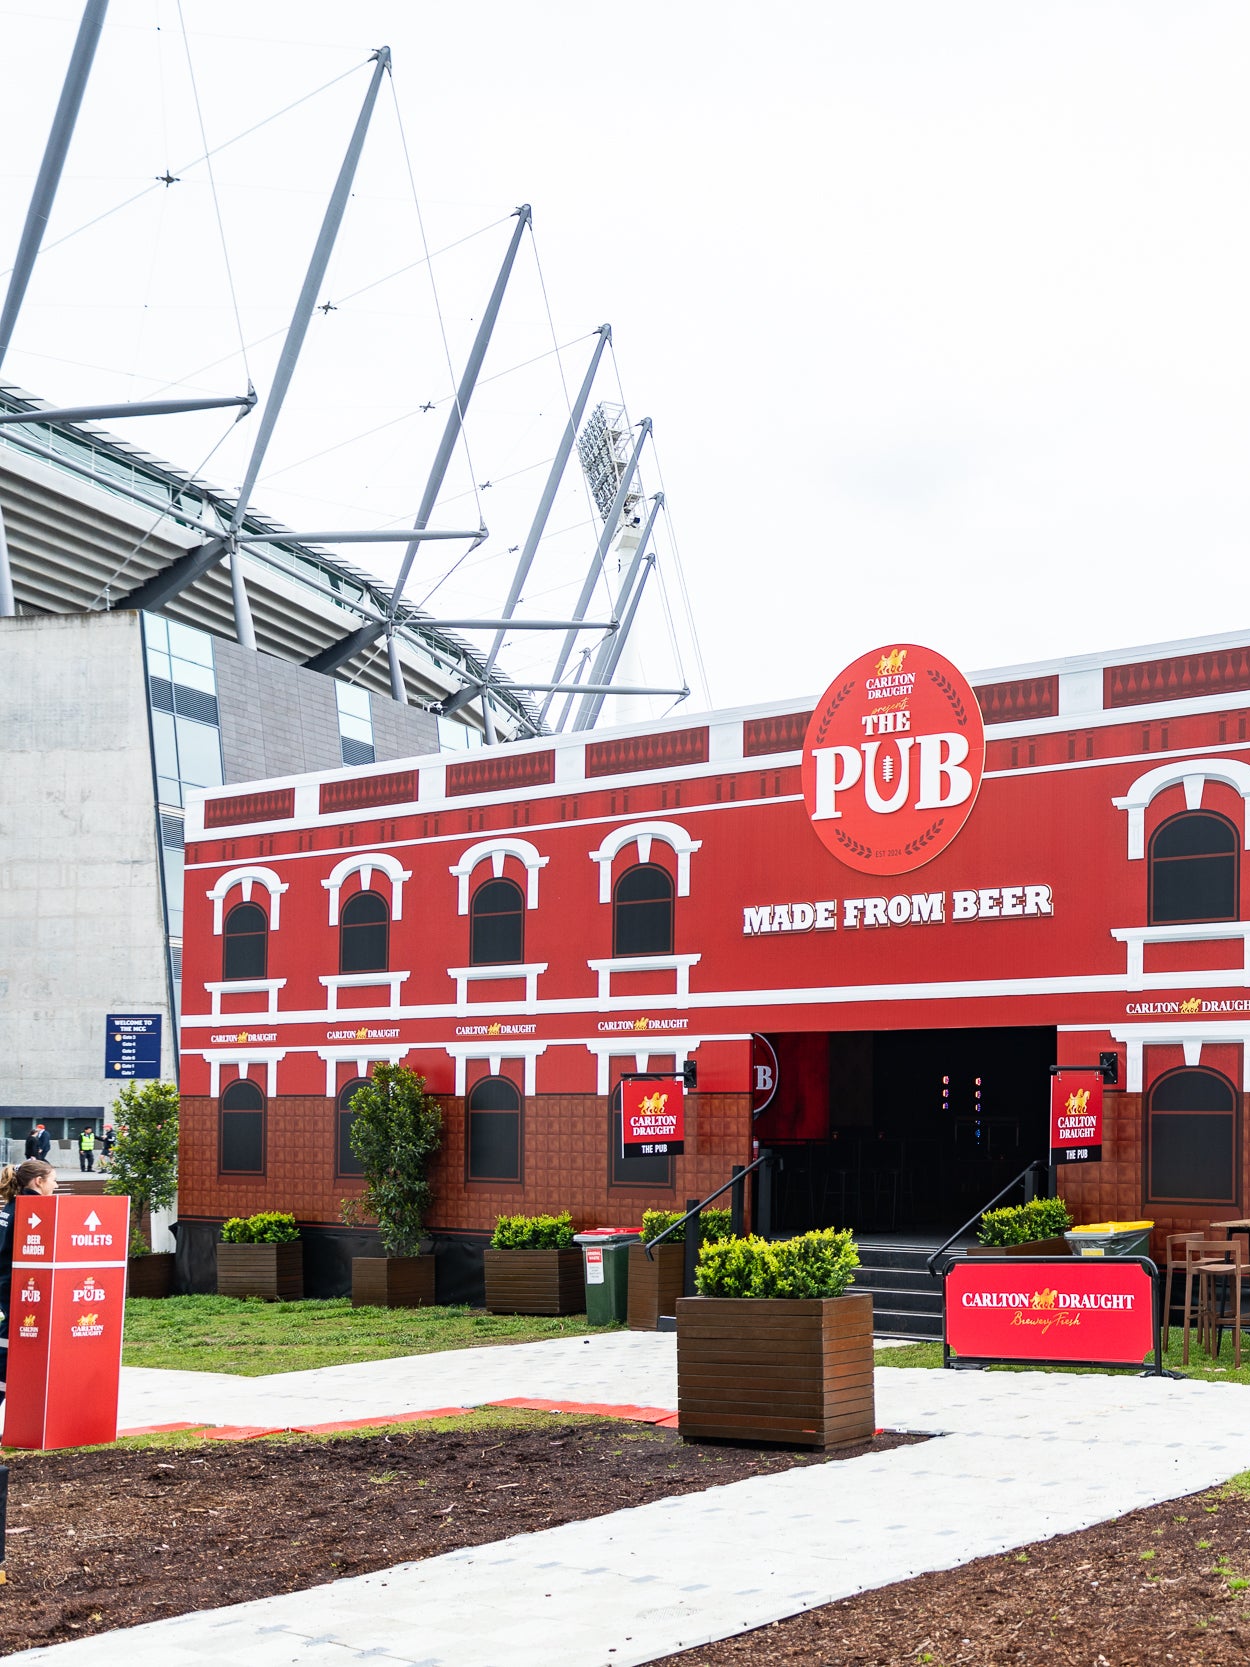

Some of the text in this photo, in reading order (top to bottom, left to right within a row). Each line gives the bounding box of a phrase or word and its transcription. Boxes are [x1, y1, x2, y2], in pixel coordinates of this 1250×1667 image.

[865, 672, 916, 690] CARLTON
[867, 684, 914, 700] DRAUGHT
[861, 710, 911, 736] THE
[811, 732, 973, 821] PUB
[743, 883, 1054, 936] MADE FROM BEER
[1126, 1000, 1180, 1015] CARLTON
[455, 1023, 537, 1035] CARLTON DRAUGHT
[598, 1018, 689, 1031] CARLTON DRAUGHT
[211, 1032, 278, 1043] CARLTON DRAUGHT
[327, 1028, 400, 1039] CARLTON DRAUGHT
[630, 1115, 677, 1127] CARLTON
[1057, 1116, 1097, 1128] CARLTON
[633, 1126, 676, 1136] DRAUGHT
[1059, 1128, 1095, 1139] DRAUGHT
[641, 1144, 668, 1154] THE PUB
[1066, 1149, 1088, 1160] THE PUB
[27, 1234, 41, 1245] BEER
[71, 1234, 113, 1247] TOILETS
[22, 1245, 45, 1255] GARDEN
[21, 1289, 41, 1302] PUB
[72, 1288, 106, 1302] PUB
[962, 1292, 1135, 1310] CARLTON DRAUGHT
[1010, 1310, 1081, 1334] Brewery Fresh
[71, 1325, 104, 1333] CARLTON
